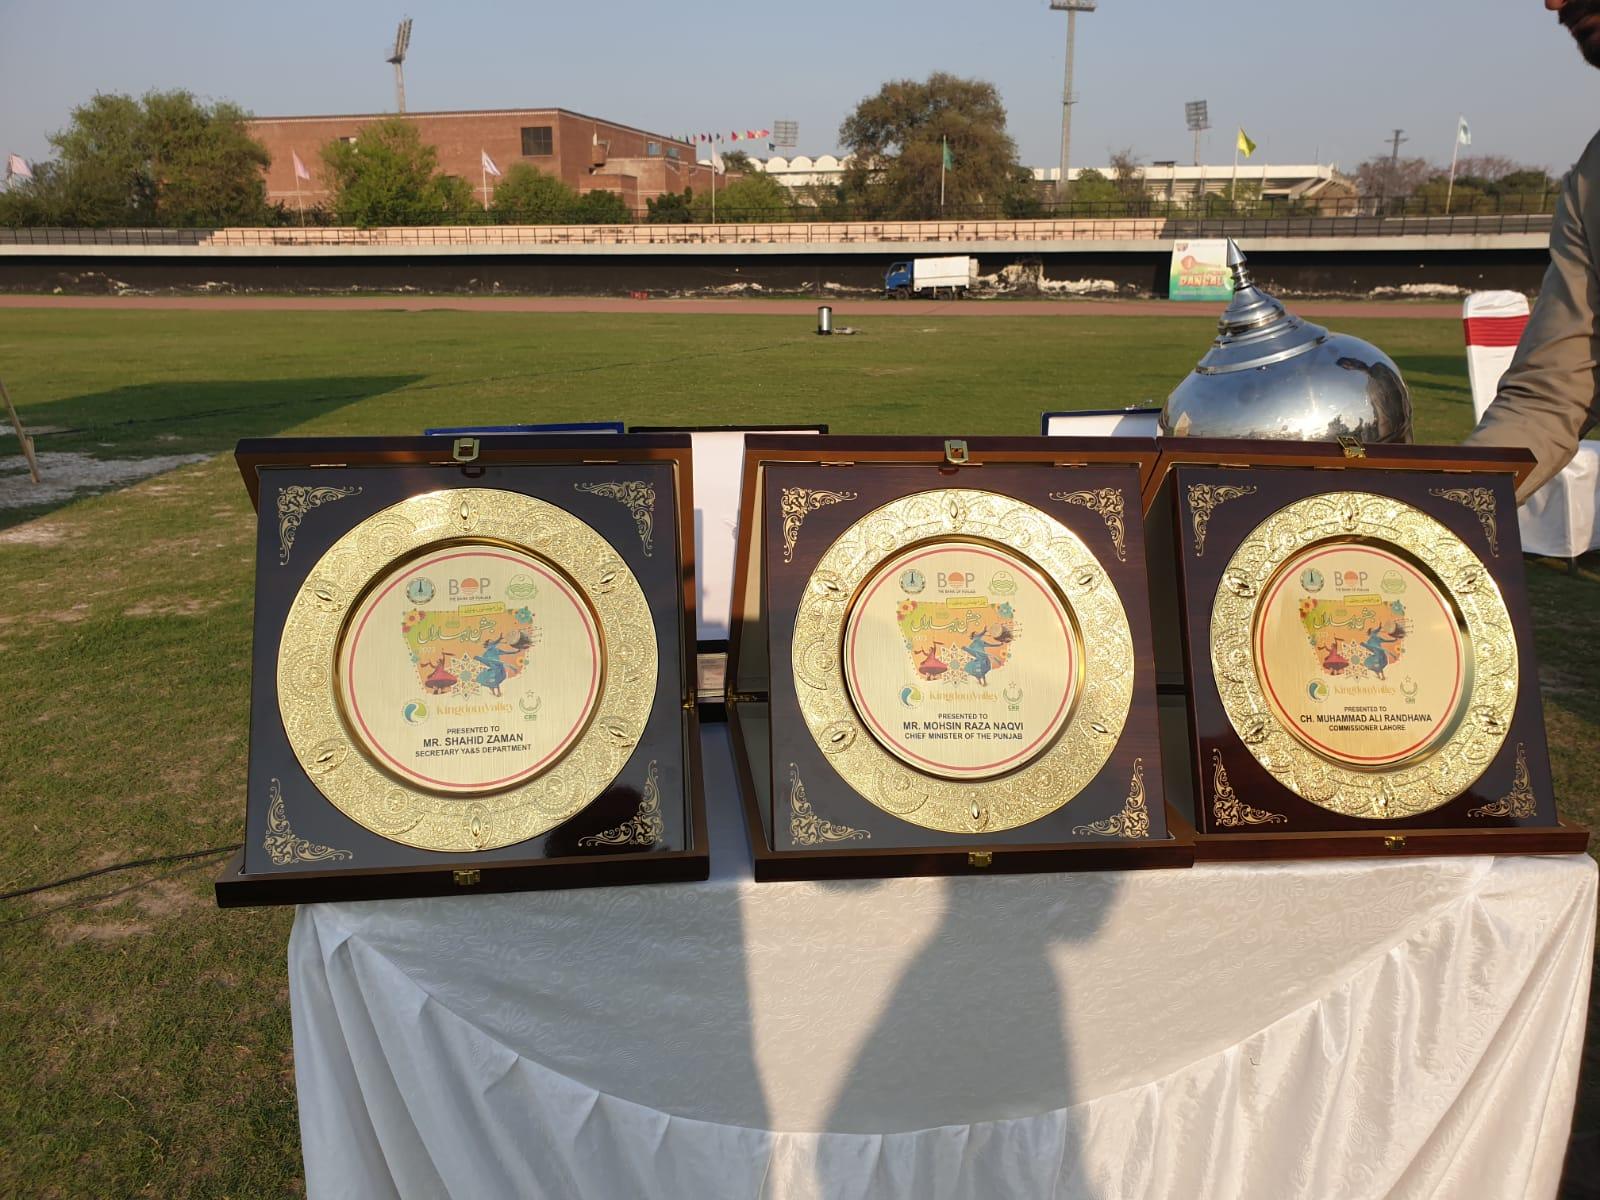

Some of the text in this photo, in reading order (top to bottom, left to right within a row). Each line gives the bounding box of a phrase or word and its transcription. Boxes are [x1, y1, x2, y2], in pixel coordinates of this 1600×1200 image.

[446, 726, 488, 734] PRESENTED
[904, 722, 1024, 730] MR. MOHSIN RAZA NAQVI
[423, 733, 524, 748] MR. SHAHID ZAMAN
[415, 744, 532, 758] SECRETARY YA&S DEPARTMENT
